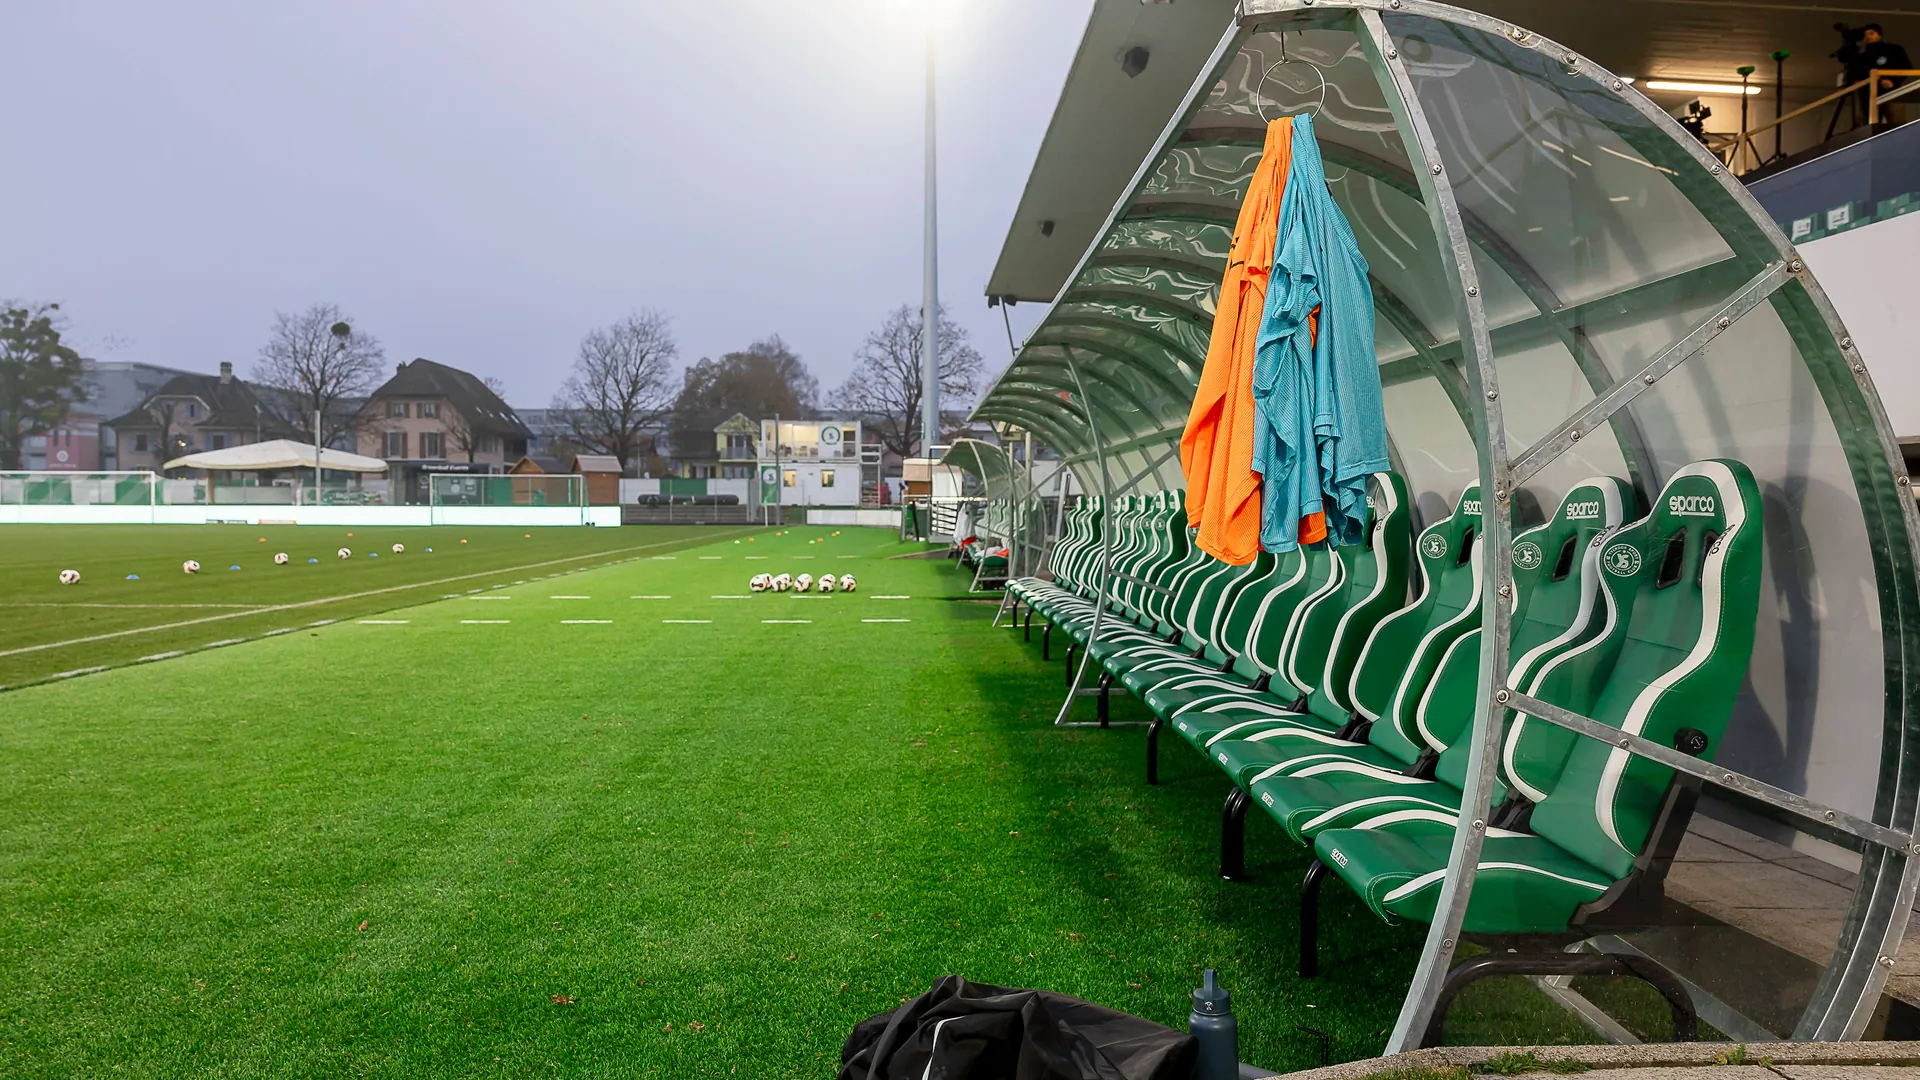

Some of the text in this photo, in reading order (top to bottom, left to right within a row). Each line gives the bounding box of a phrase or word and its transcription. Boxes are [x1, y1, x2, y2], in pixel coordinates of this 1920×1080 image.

[1463, 500, 1482, 516] spar
[1566, 501, 1599, 520] sparco
[1669, 495, 1715, 516] sparco
